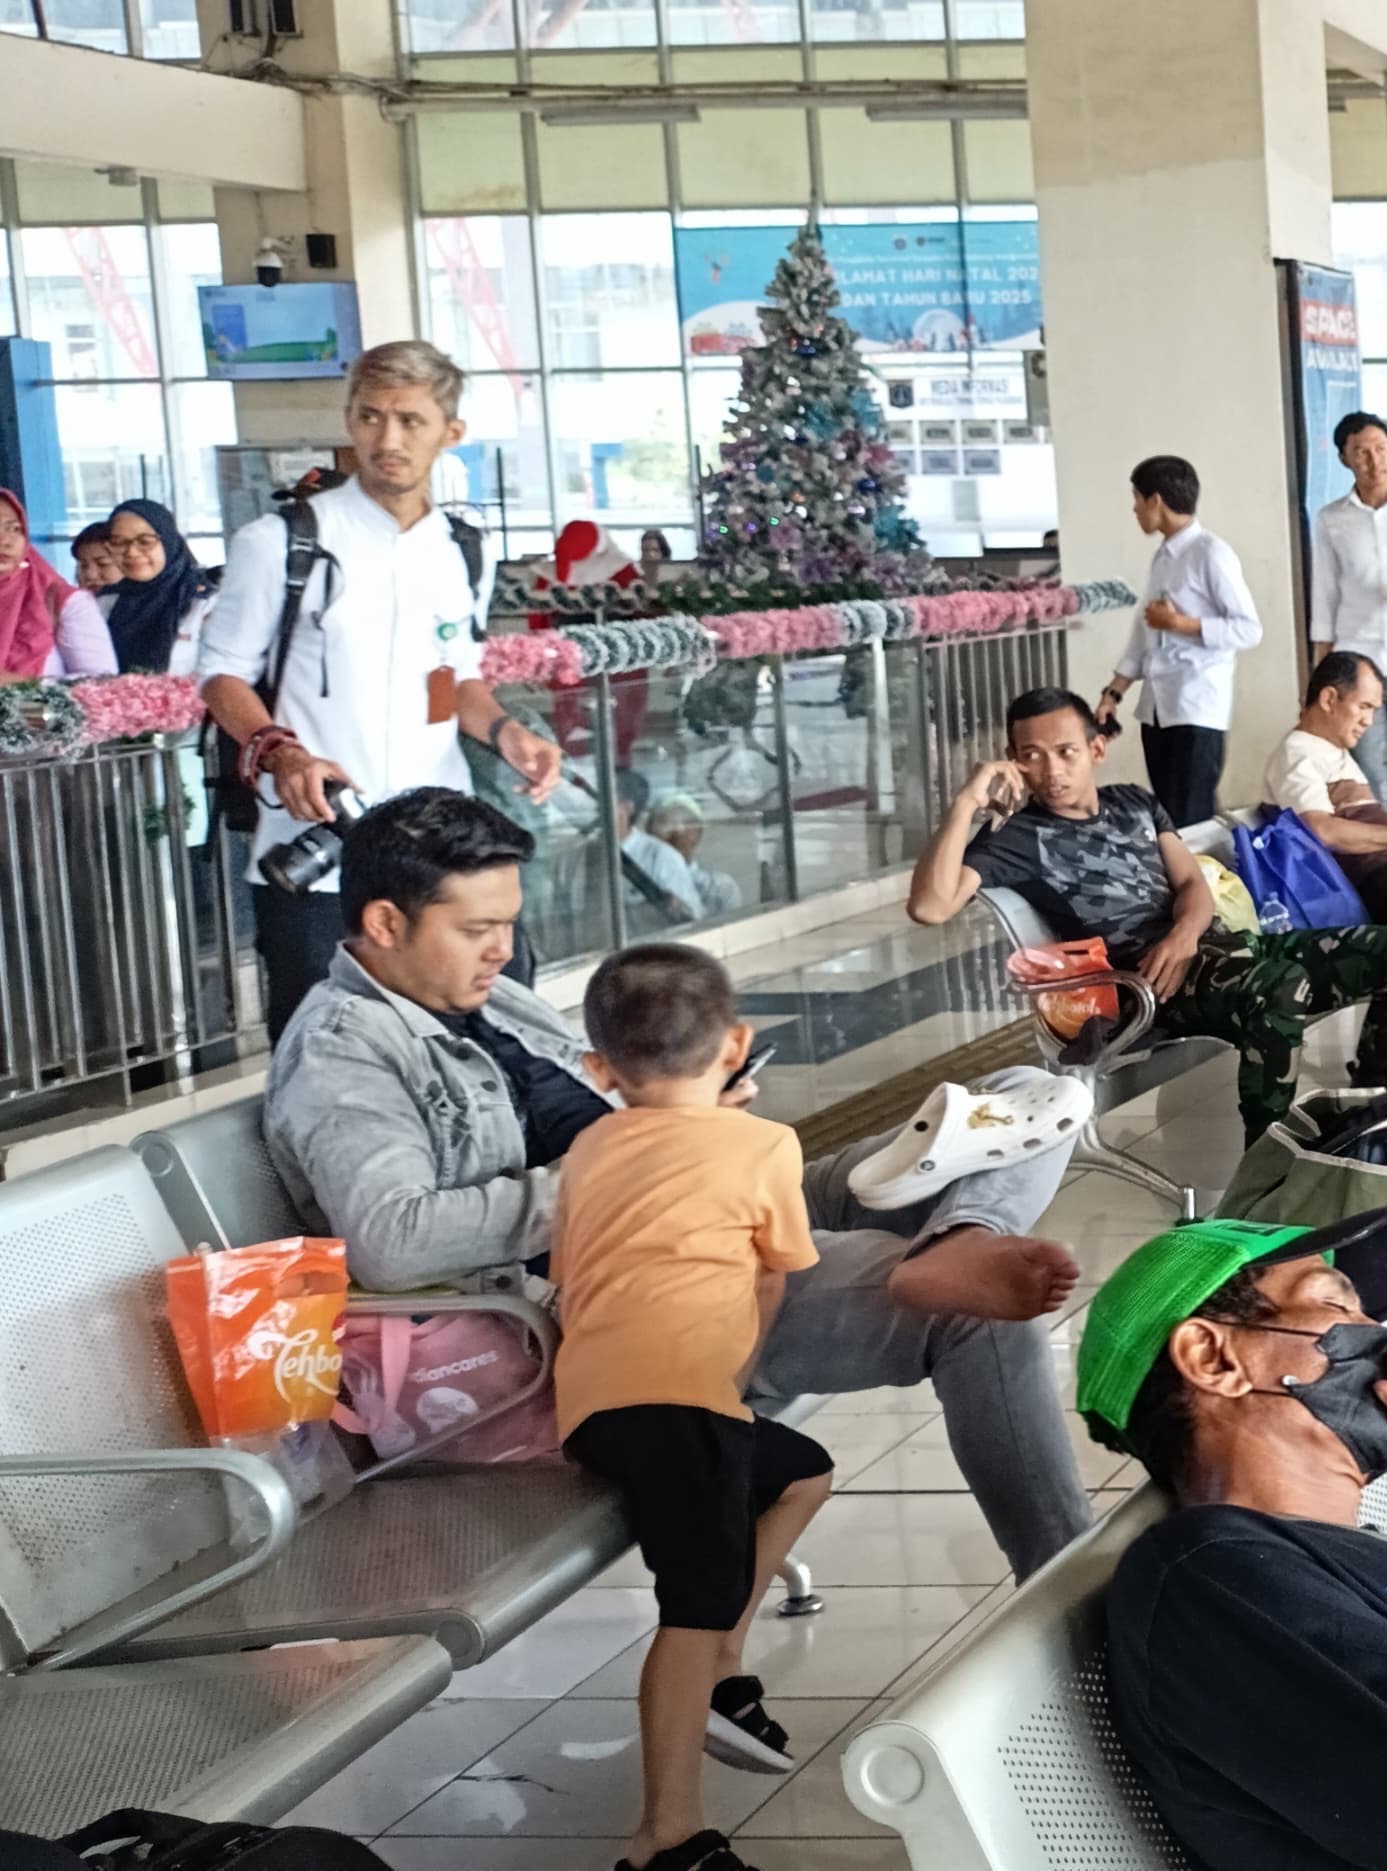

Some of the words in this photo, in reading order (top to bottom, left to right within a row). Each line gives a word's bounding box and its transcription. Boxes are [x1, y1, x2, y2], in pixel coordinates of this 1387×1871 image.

[902, 267, 941, 281] HARI
[841, 292, 876, 307] DAN
[881, 291, 936, 305] TAHUN
[991, 289, 1032, 304] 2025
